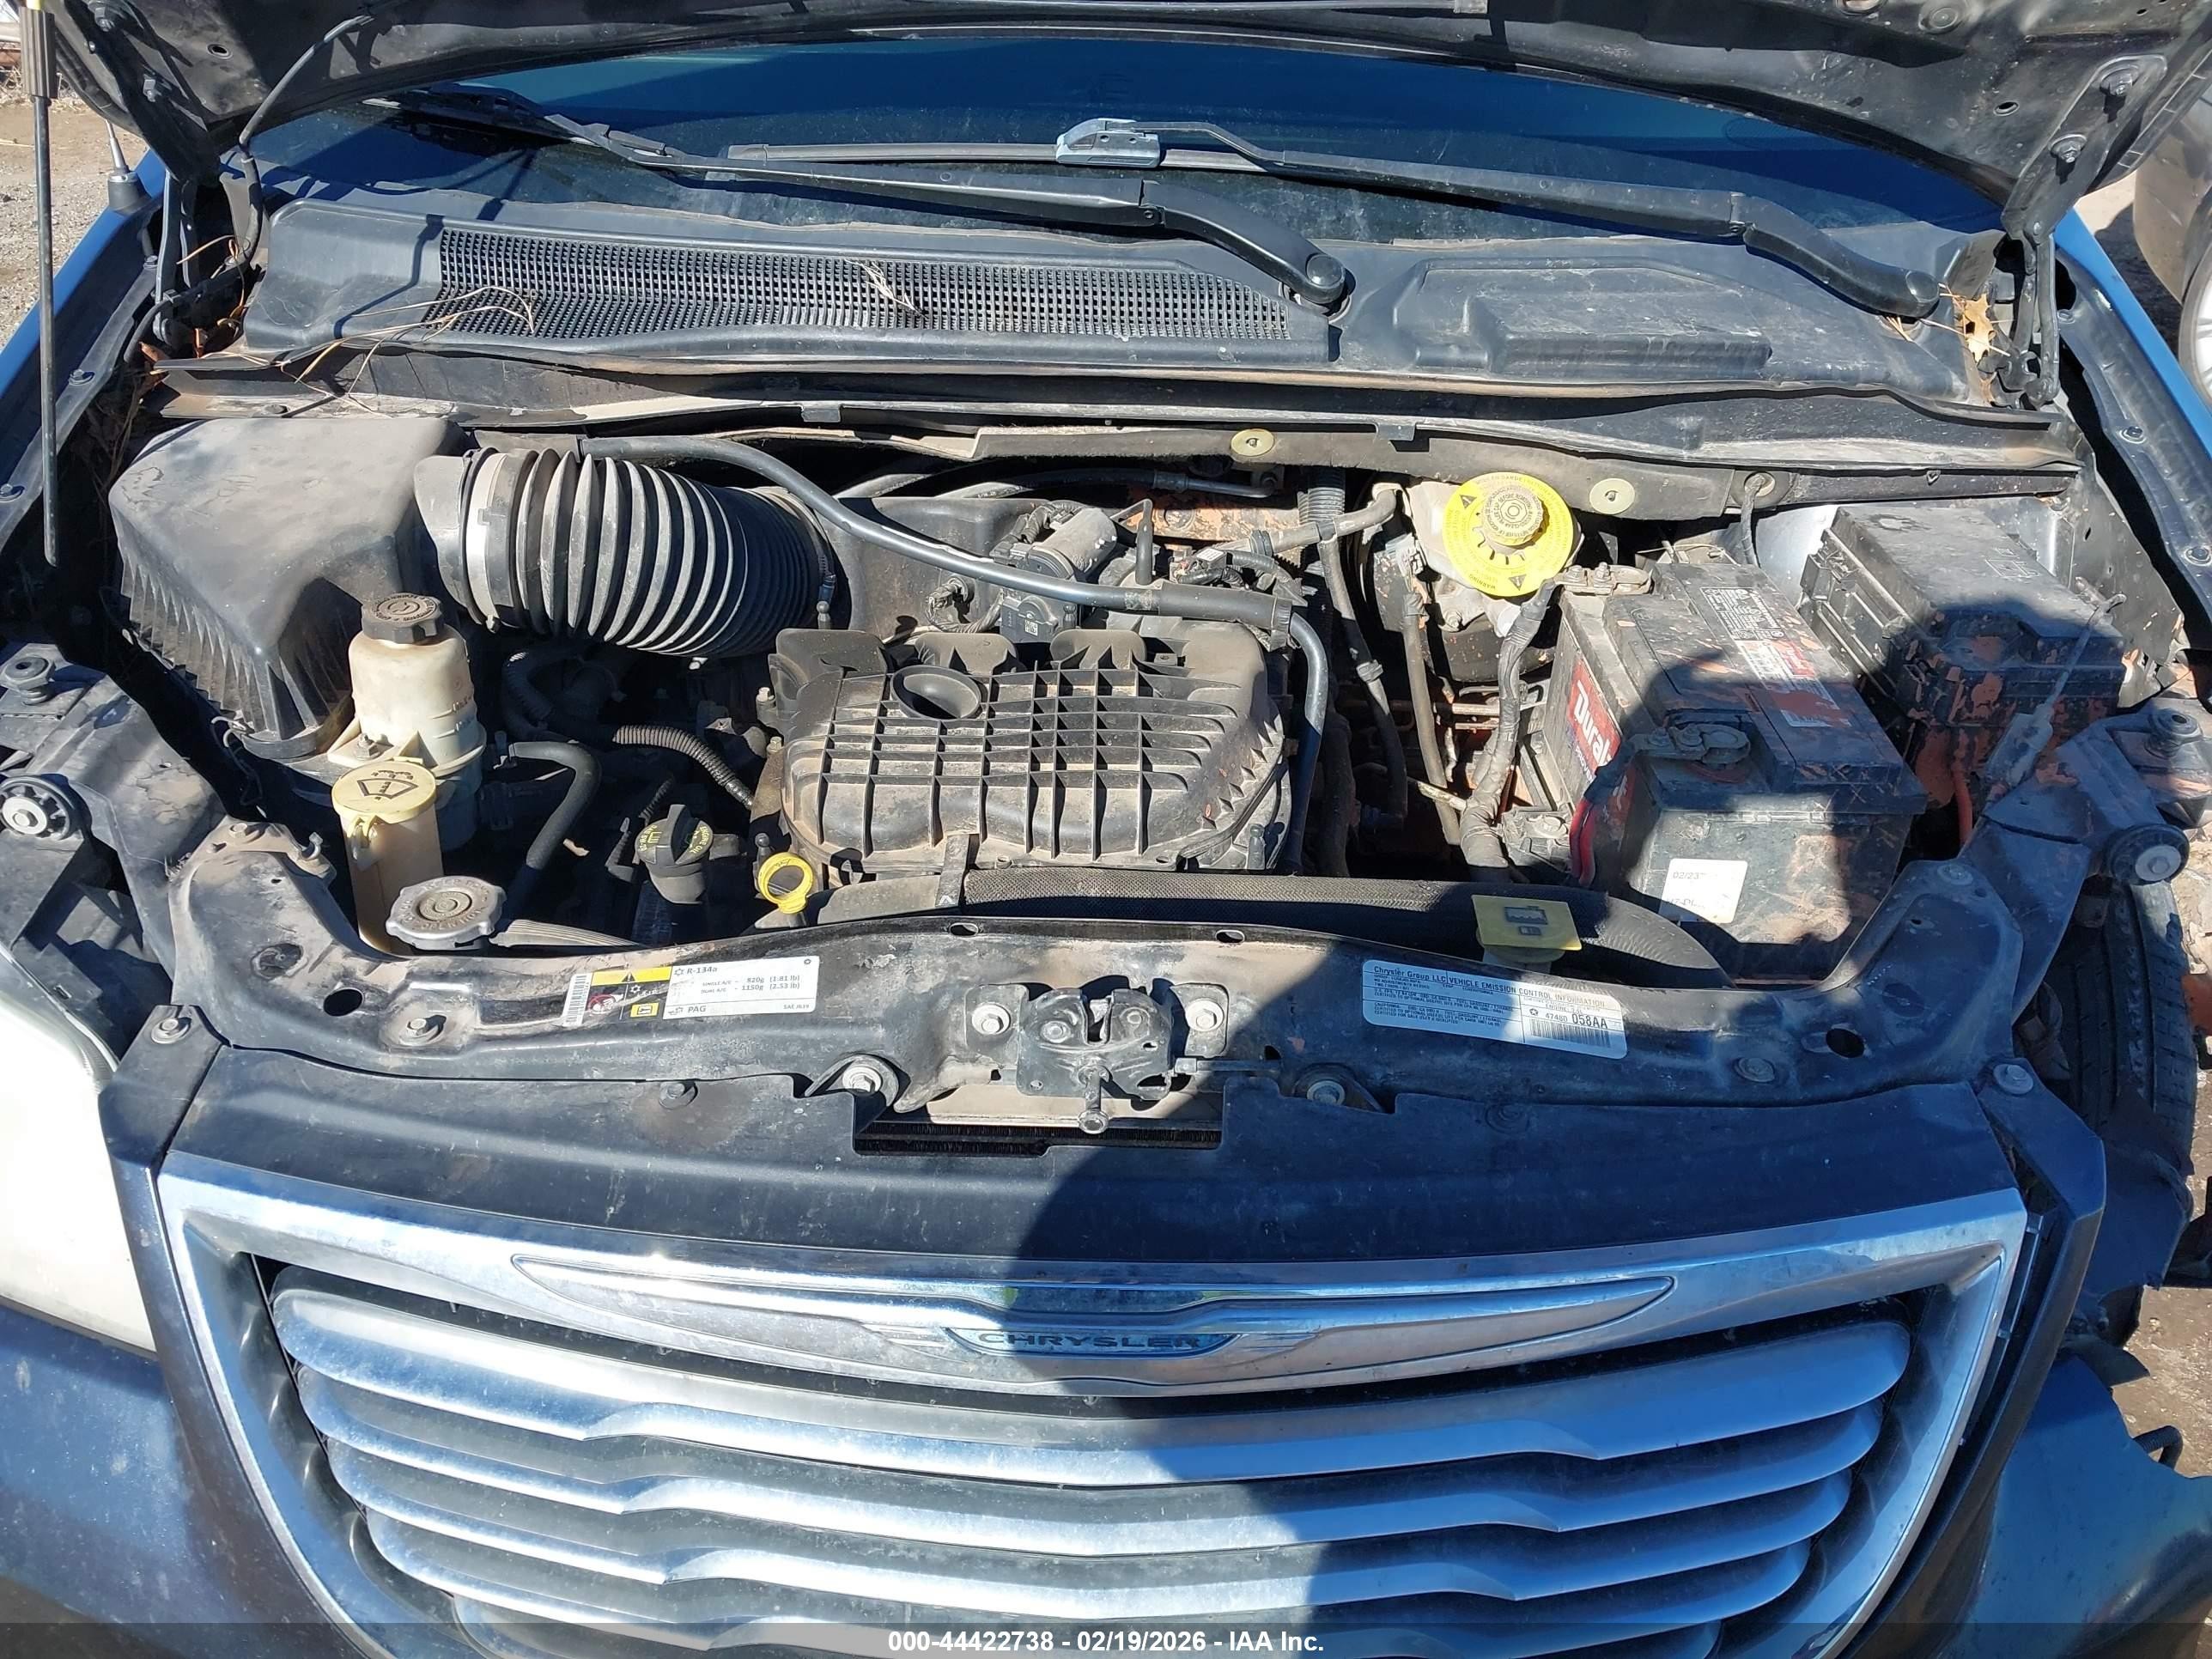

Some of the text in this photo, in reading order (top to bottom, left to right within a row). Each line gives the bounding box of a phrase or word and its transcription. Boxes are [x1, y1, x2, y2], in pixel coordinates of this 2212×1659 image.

[1468, 574, 1497, 590] WARNING
[689, 825, 710, 854] ENGINE OIL
[686, 966, 718, 975] R-134a
[1374, 965, 1405, 977] Chrysler
[1407, 970, 1430, 981] Group
[1432, 975, 1446, 983] LLC
[1448, 977, 1480, 988] VEHICLE
[1481, 981, 1516, 994] EMISSION
[1518, 988, 1553, 1000] CONTROL
[1554, 994, 1606, 1007] INFORMATION
[1571, 1013, 1608, 1029] 058AA
[977, 1333, 1202, 1349] CHRYSLER
